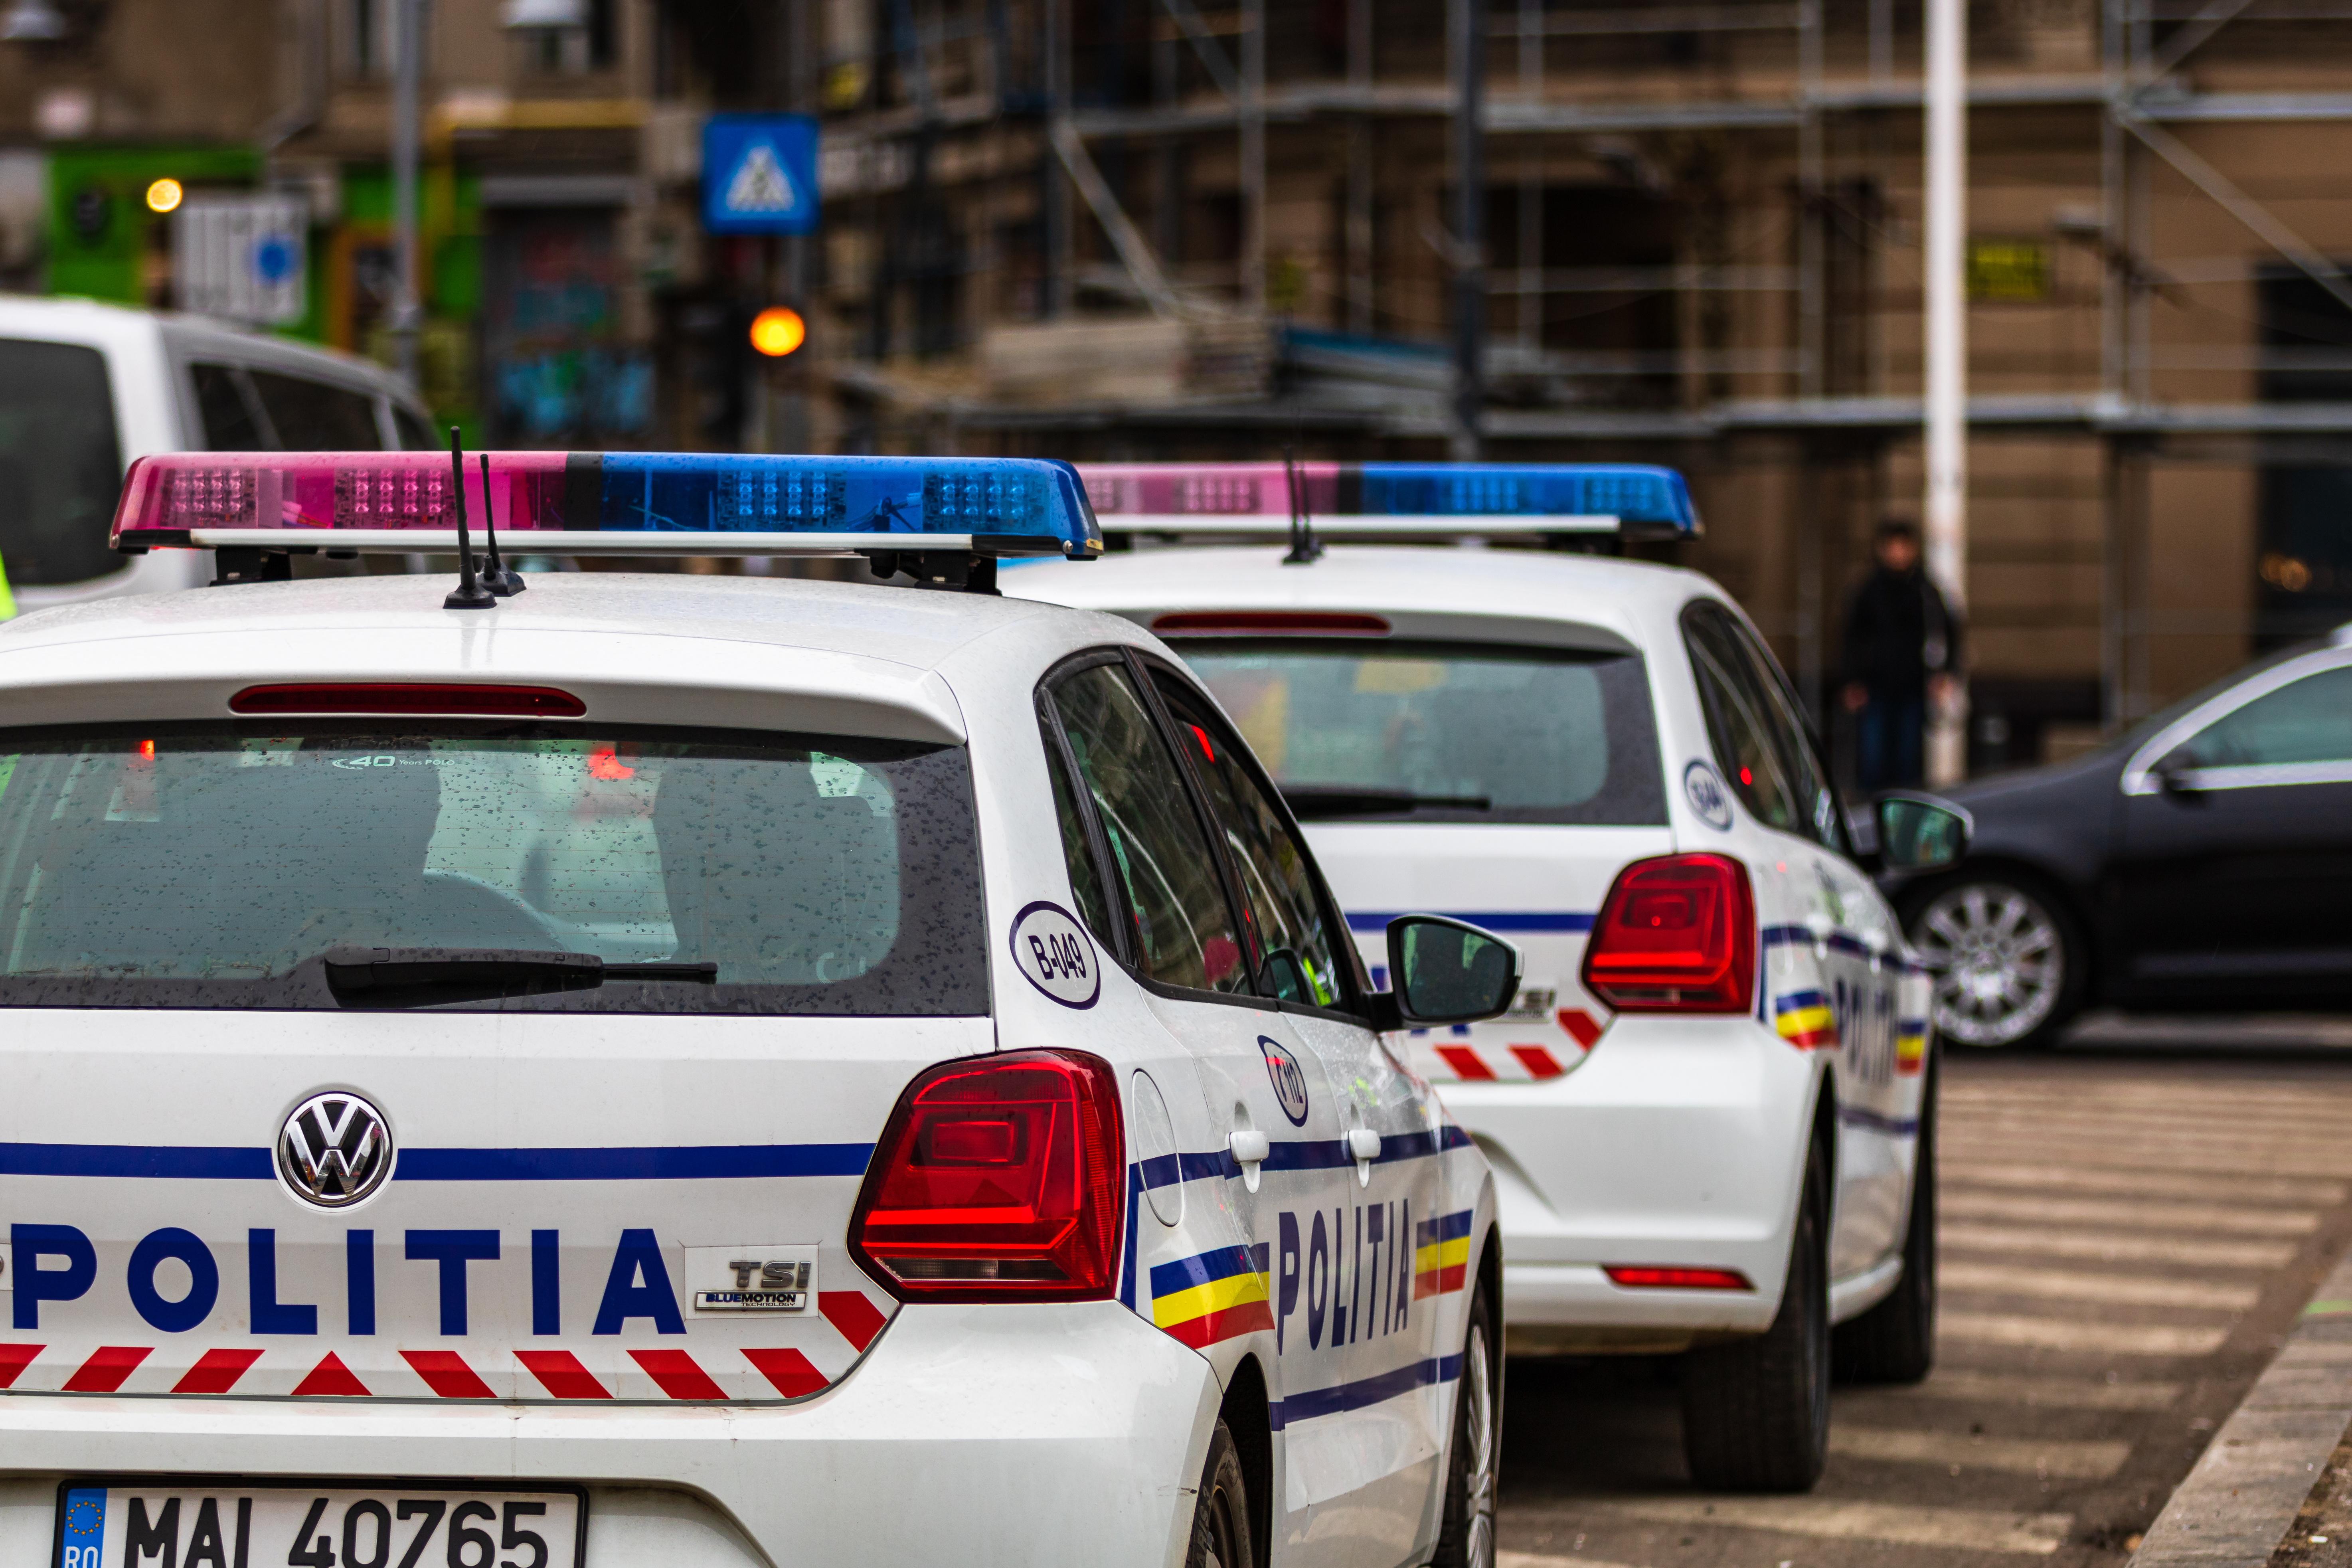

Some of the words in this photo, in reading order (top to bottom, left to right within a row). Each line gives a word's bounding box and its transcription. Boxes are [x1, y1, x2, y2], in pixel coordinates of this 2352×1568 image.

[350, 756, 395, 767] 40
[1028, 933, 1087, 980] B-049
[11, 1223, 687, 1336] POLITIA
[730, 1261, 811, 1287] TSI
[1277, 1198, 1410, 1356] POLITIA
[705, 1293, 797, 1303] BLUEMOTION
[123, 1497, 252, 1568] MAI
[288, 1497, 548, 1568] 40765
[64, 1546, 99, 1568] RO
